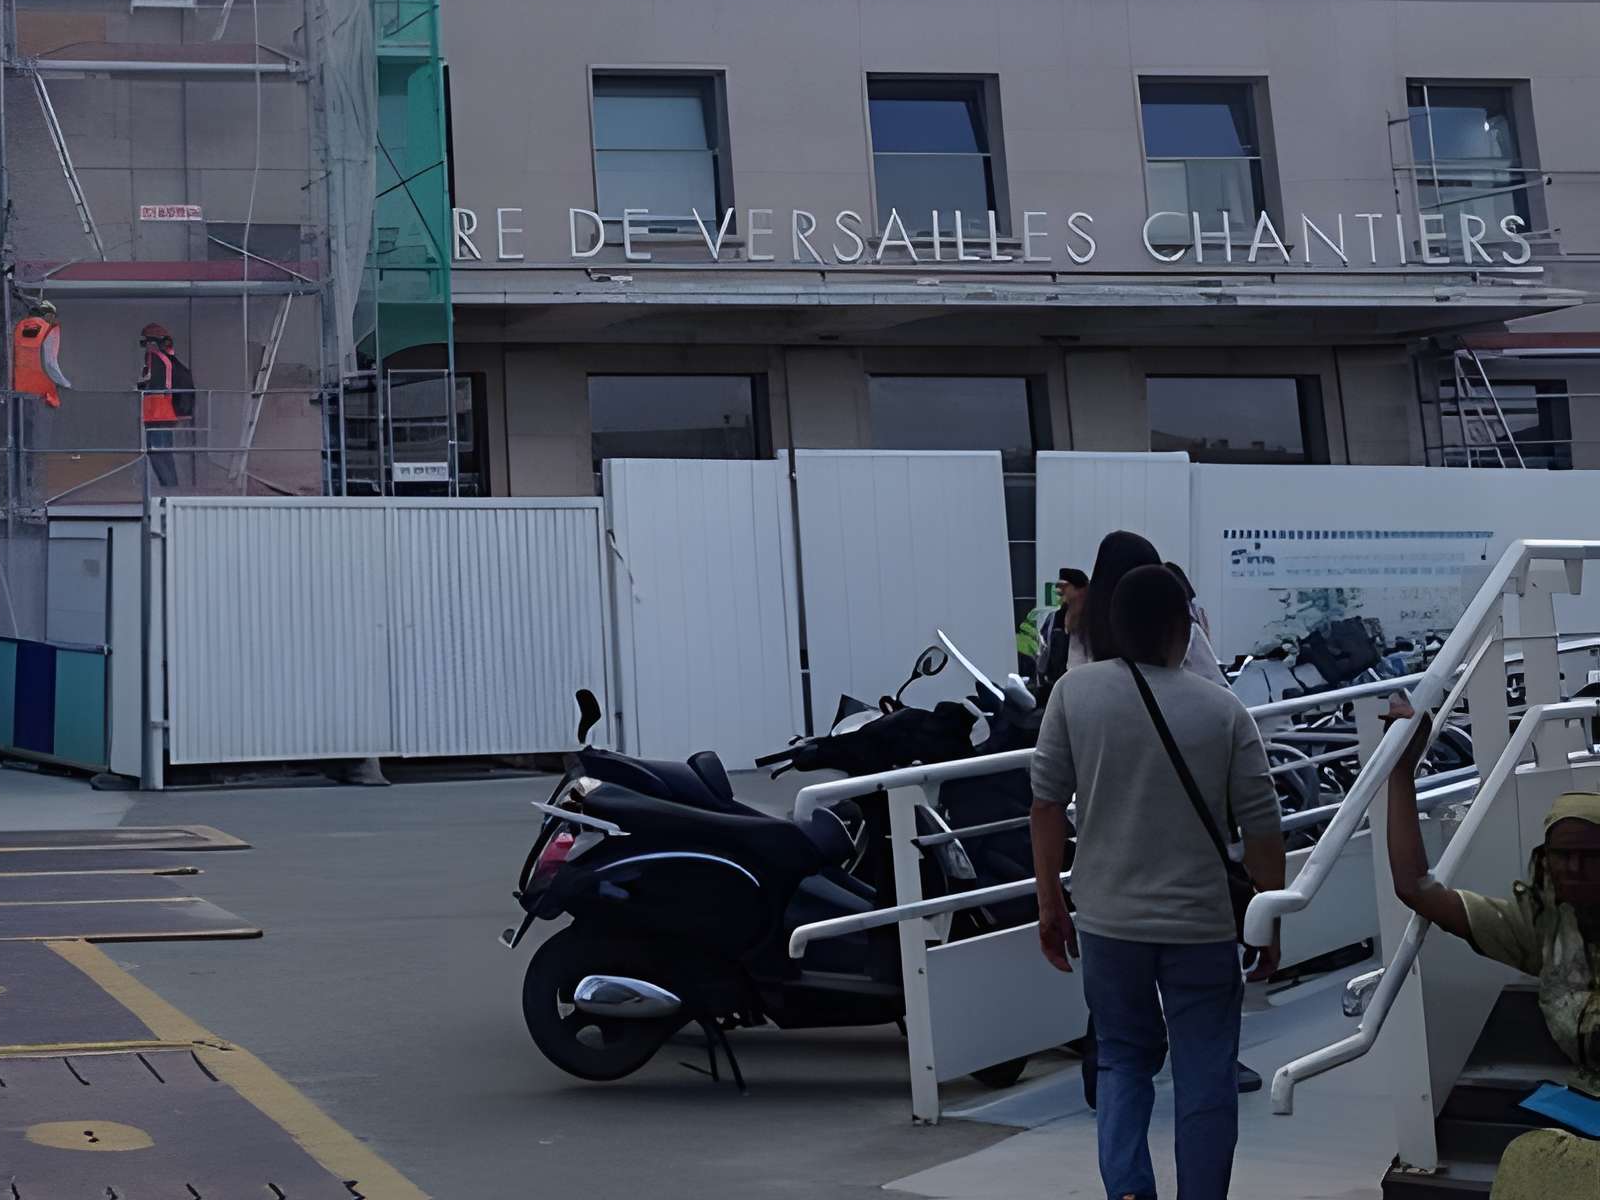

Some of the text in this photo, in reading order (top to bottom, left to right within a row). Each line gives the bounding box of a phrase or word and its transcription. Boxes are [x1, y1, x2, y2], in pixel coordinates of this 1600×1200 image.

[569, 208, 652, 263] DE
[692, 207, 1097, 264] VERSAILLES
[1143, 209, 1532, 266] CHANTIERS
